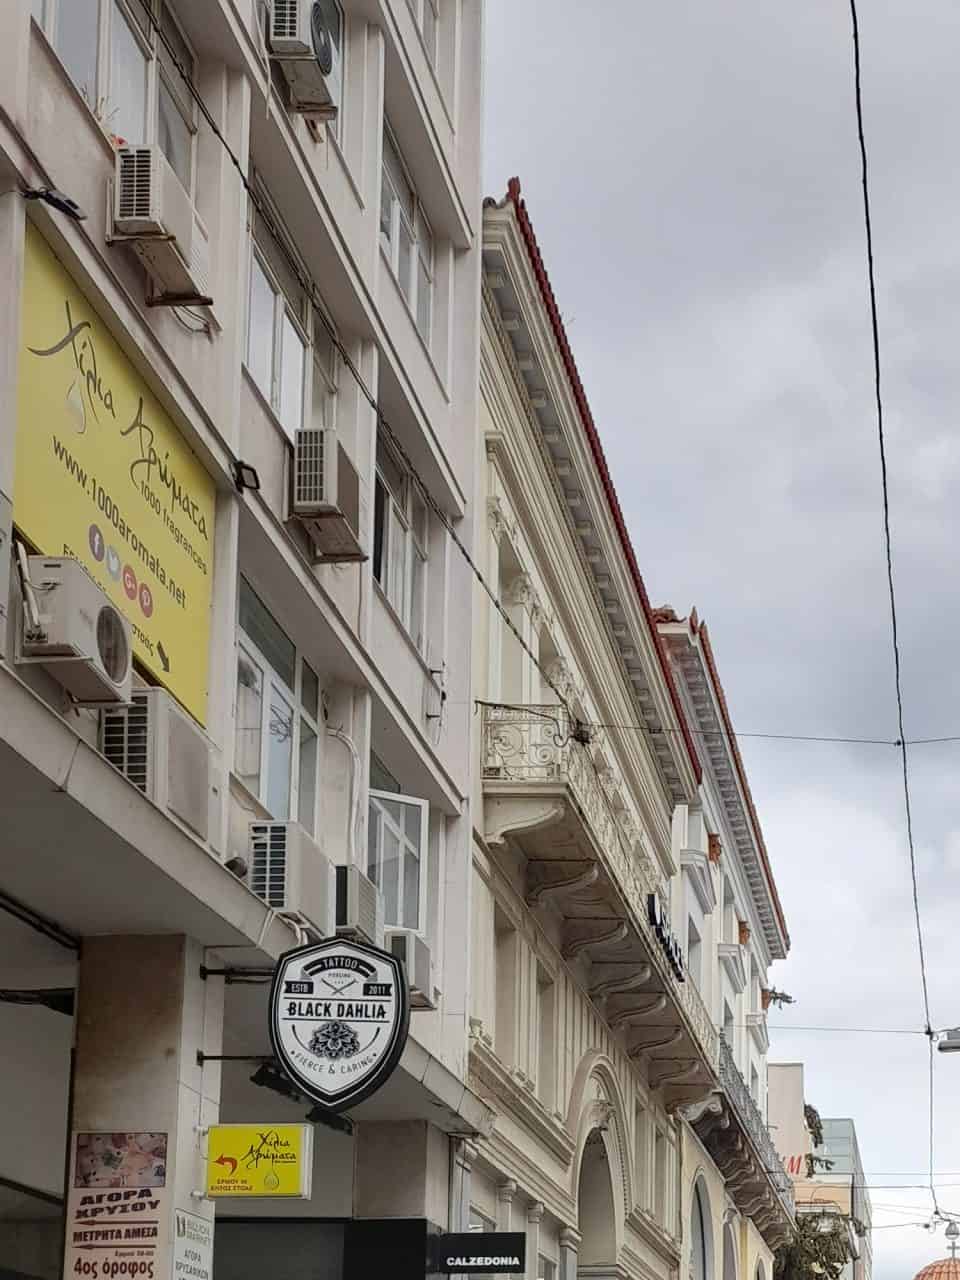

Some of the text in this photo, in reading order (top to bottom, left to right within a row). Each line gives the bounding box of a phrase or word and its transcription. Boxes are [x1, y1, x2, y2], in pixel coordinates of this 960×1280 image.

[53, 435, 186, 609] www.1000aromata.net
[323, 957, 358, 969] TATTOO
[369, 986, 387, 995] 2011
[287, 1002, 388, 1019] BLACK DAHLIA
[80, 1189, 152, 1206] ΑΓΟΡΑ
[75, 1200, 160, 1219] ΧΡΥΣΟΥ
[73, 1227, 158, 1242] ΜΕΤΡΗΤΑ ΑΜΕΣΑ
[74, 1257, 154, 1279] 4ος όροφος
[447, 1257, 520, 1266] CALZEDONIA
